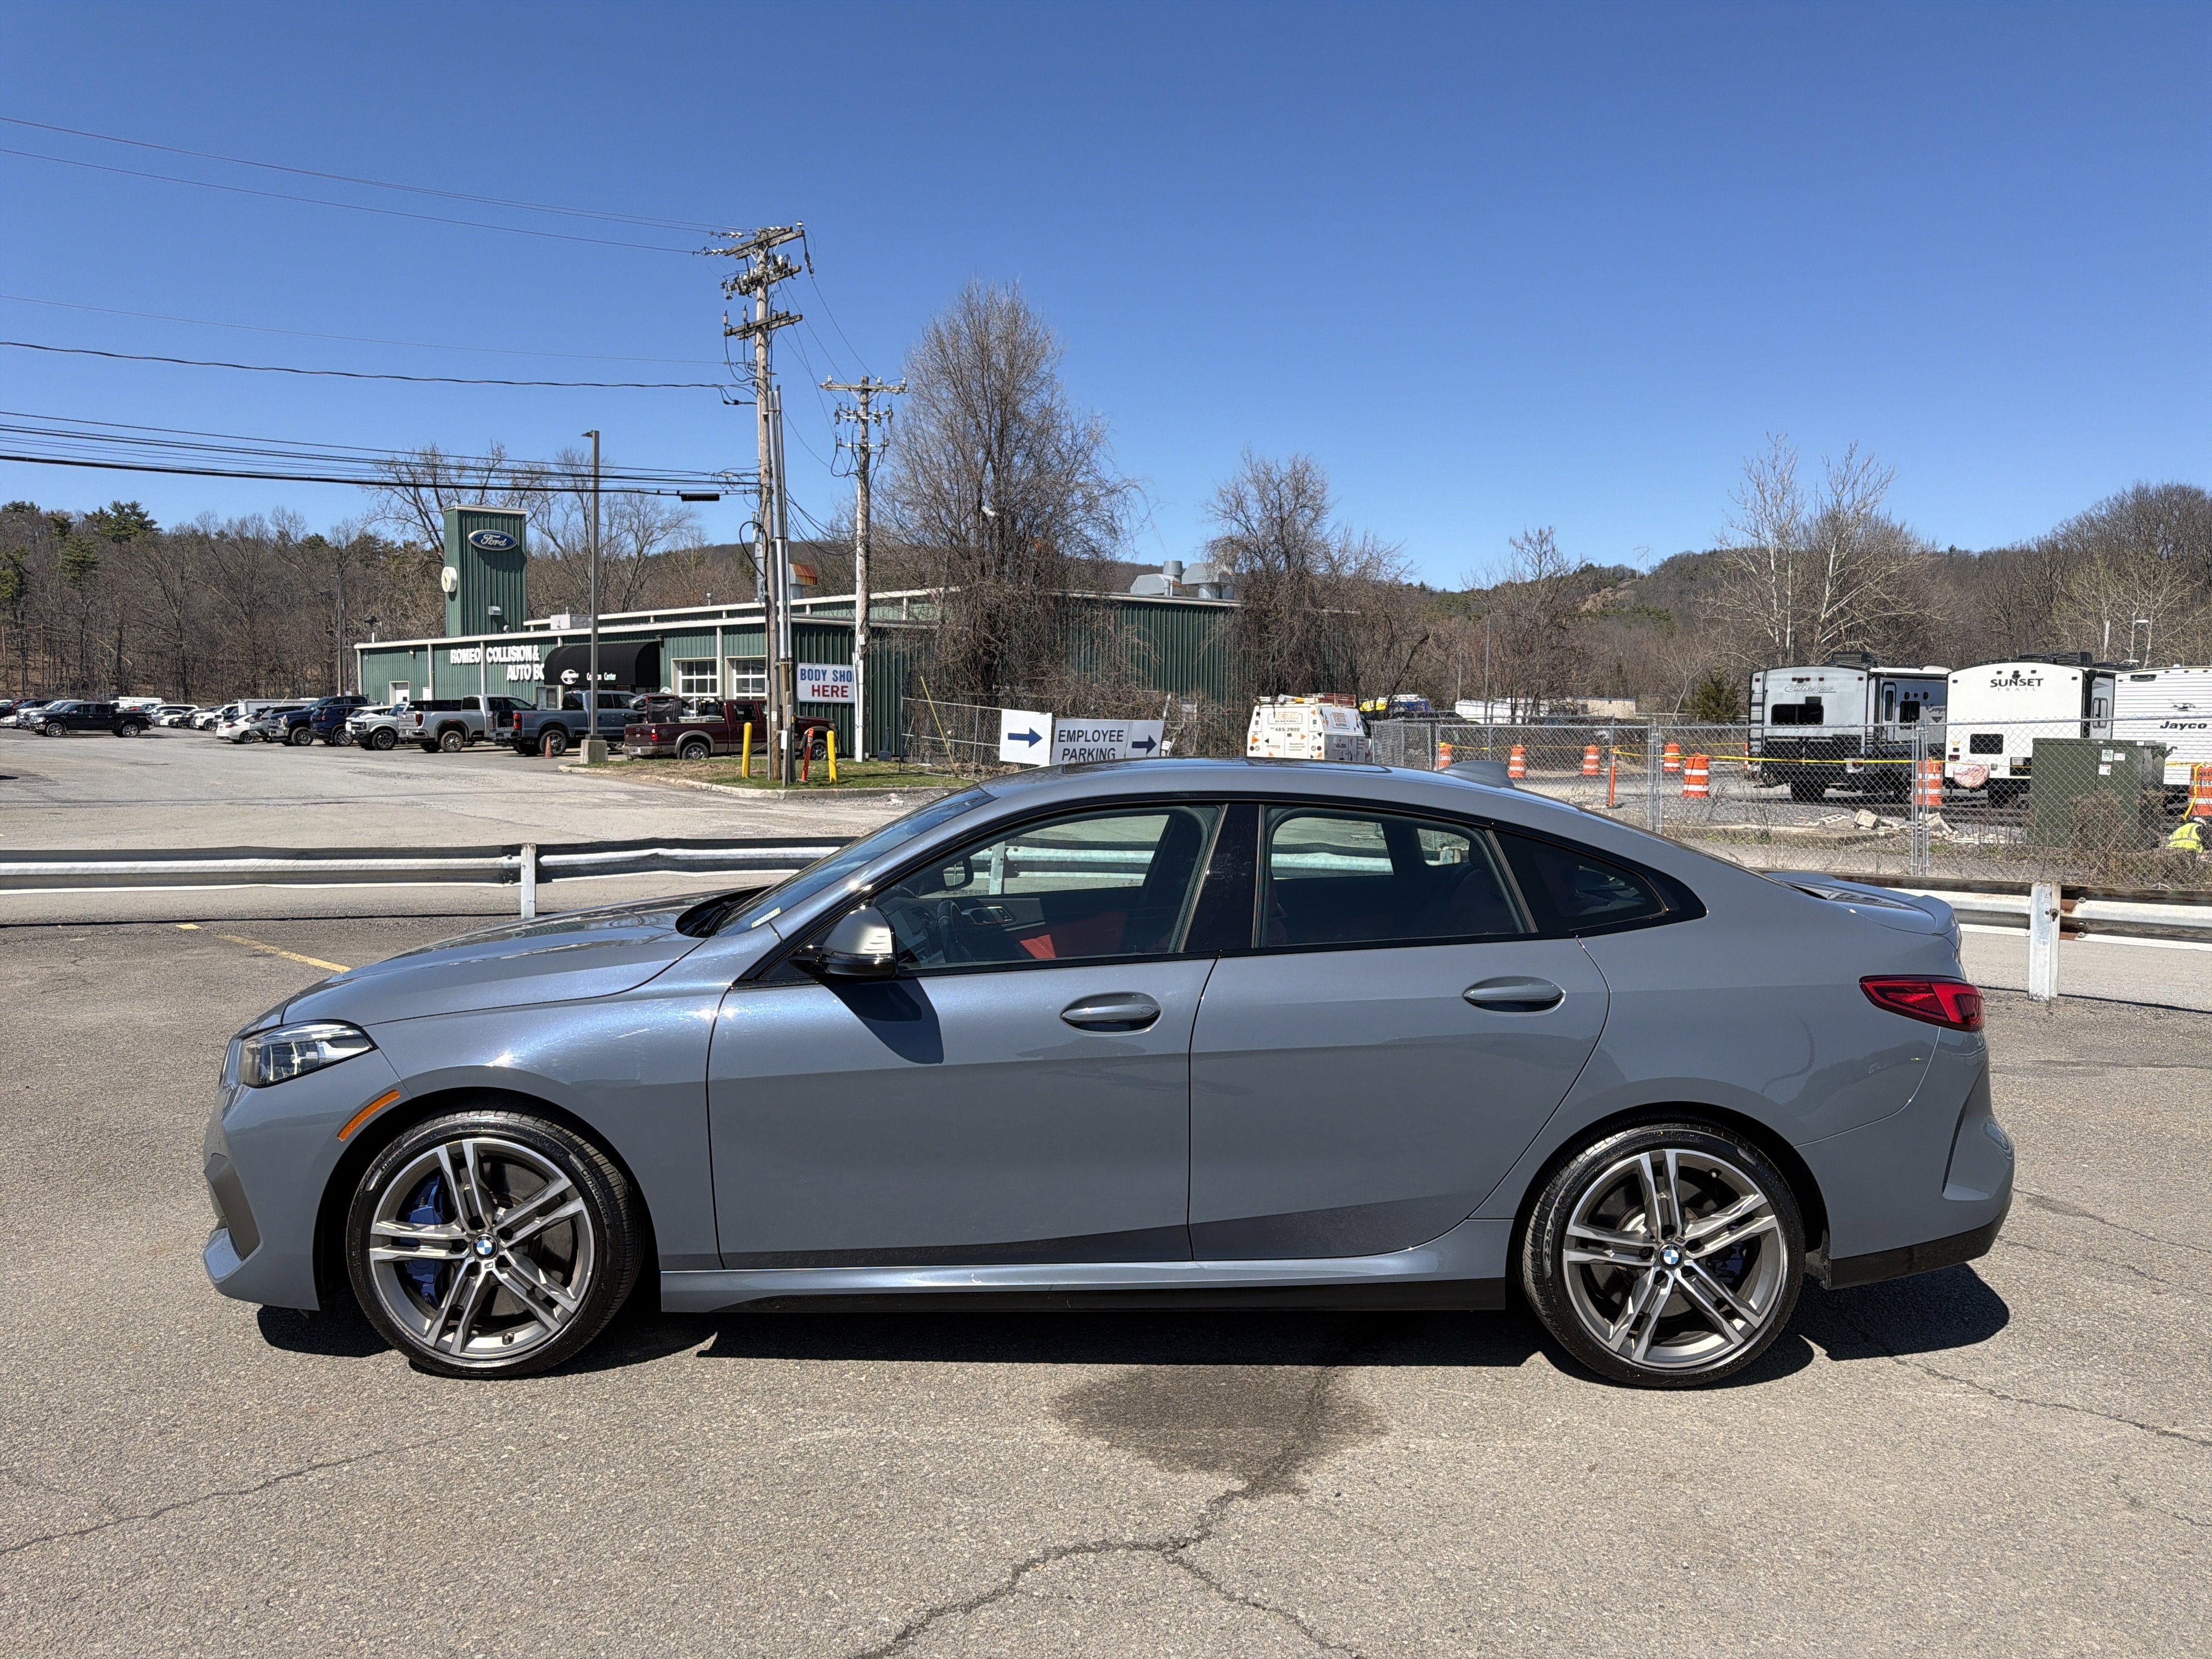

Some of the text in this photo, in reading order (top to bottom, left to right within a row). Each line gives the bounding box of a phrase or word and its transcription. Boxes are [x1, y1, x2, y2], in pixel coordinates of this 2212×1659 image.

[481, 534, 507, 546] Ford
[450, 647, 481, 664] ROMEO
[507, 663, 545, 680] AUTO BO
[800, 669, 854, 682] BODY SHO
[1990, 678, 2044, 687] SUNSET
[811, 685, 849, 698] HERE
[2160, 721, 2208, 730] Jayco
[1058, 730, 1124, 742] EMPLOYEE
[1062, 748, 1116, 762] PARKING
[581, 1169, 609, 1218] Cinturato
